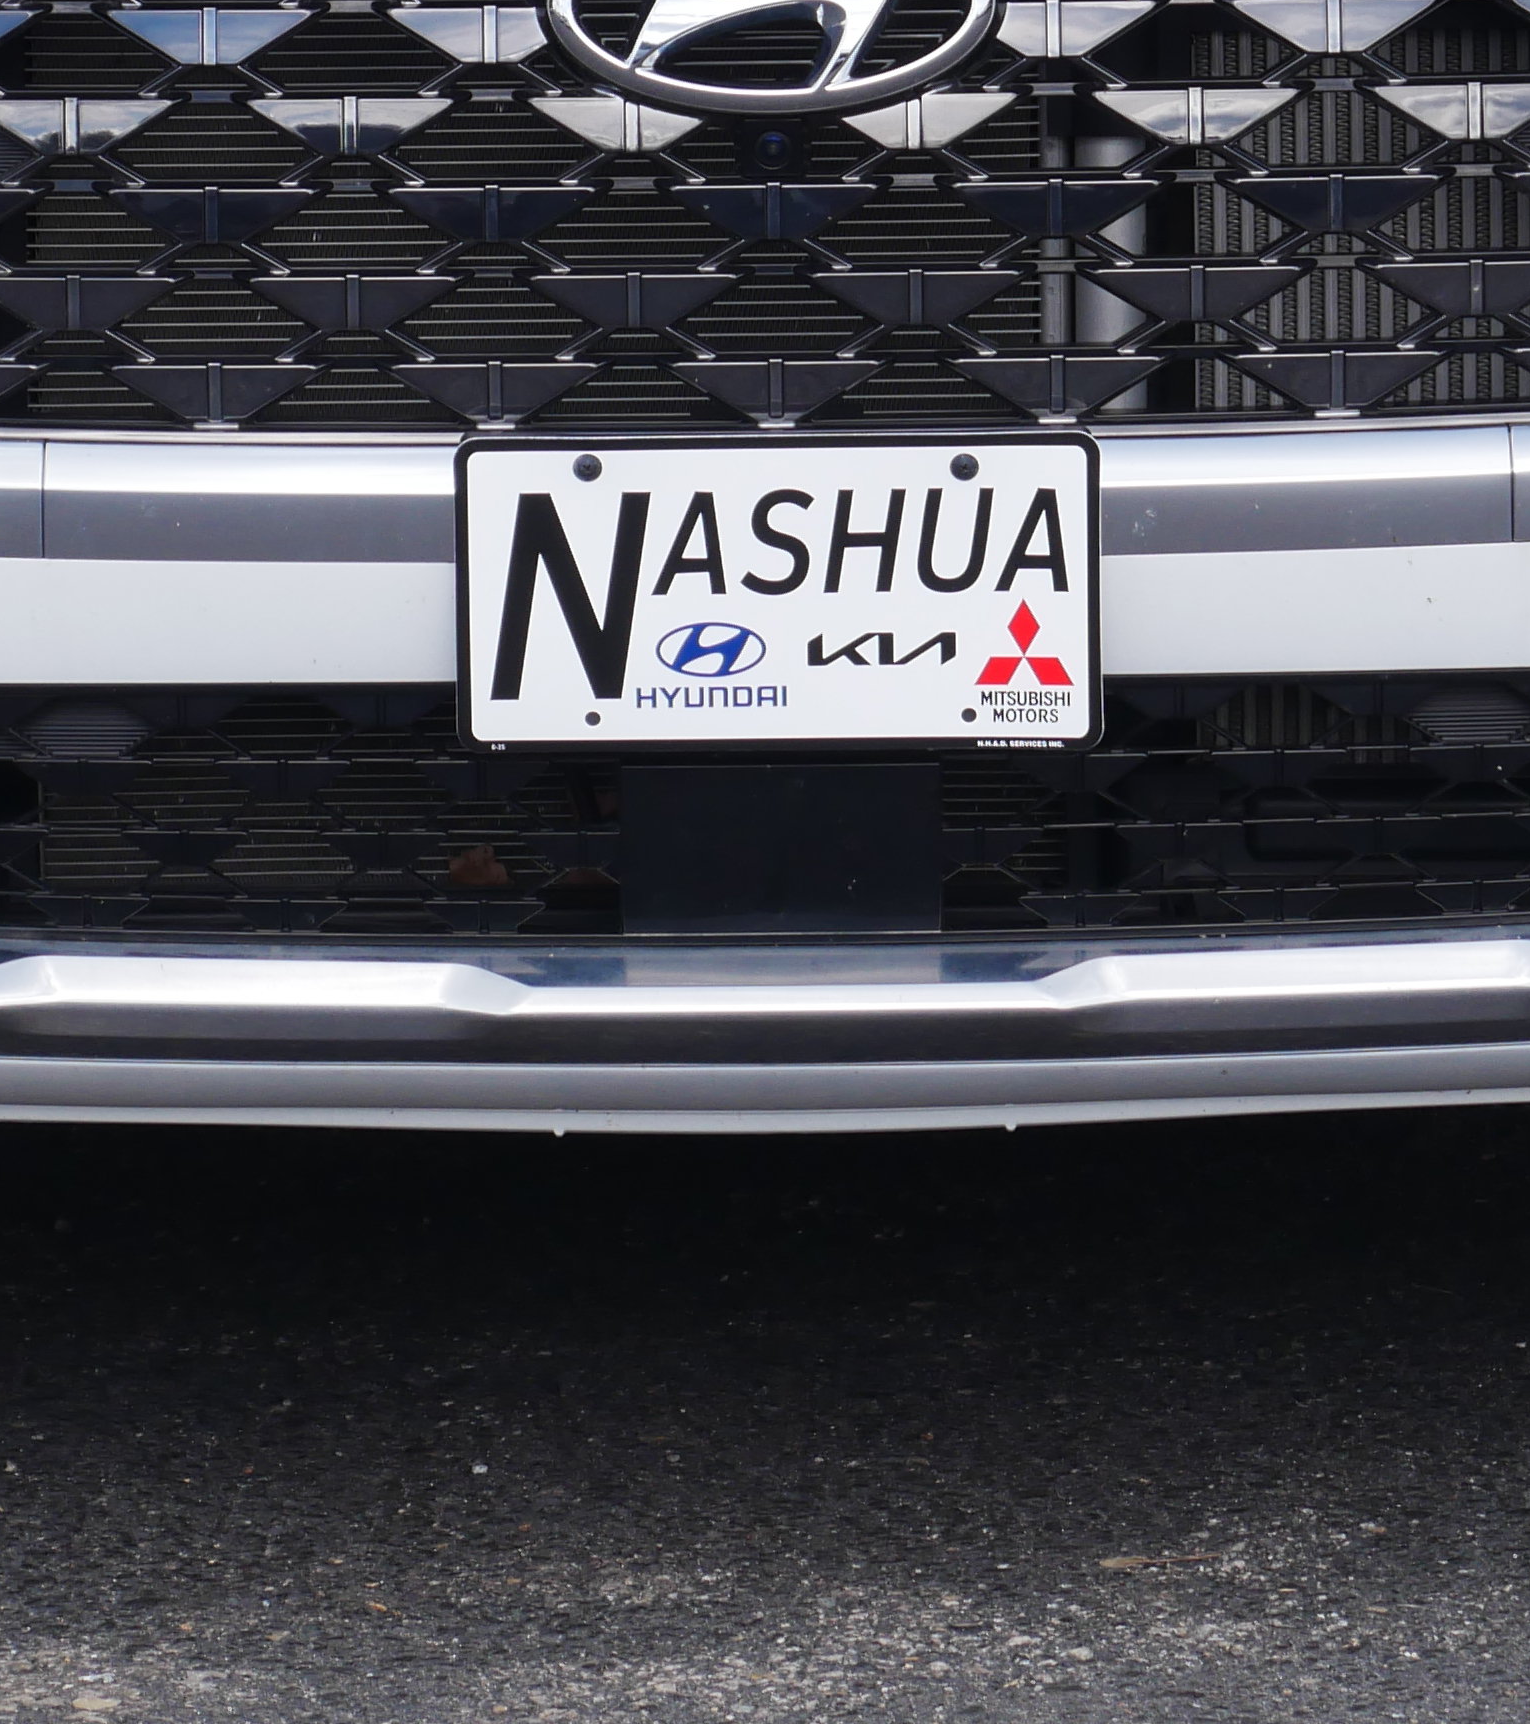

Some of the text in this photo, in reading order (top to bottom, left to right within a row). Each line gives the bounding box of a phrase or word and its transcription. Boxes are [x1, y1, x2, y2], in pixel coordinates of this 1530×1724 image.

[489, 487, 1070, 701] NASHUA
[636, 686, 788, 708] HYUNDAI
[981, 690, 1071, 707] MITSUBISHI
[993, 708, 1059, 723] MOTORS
